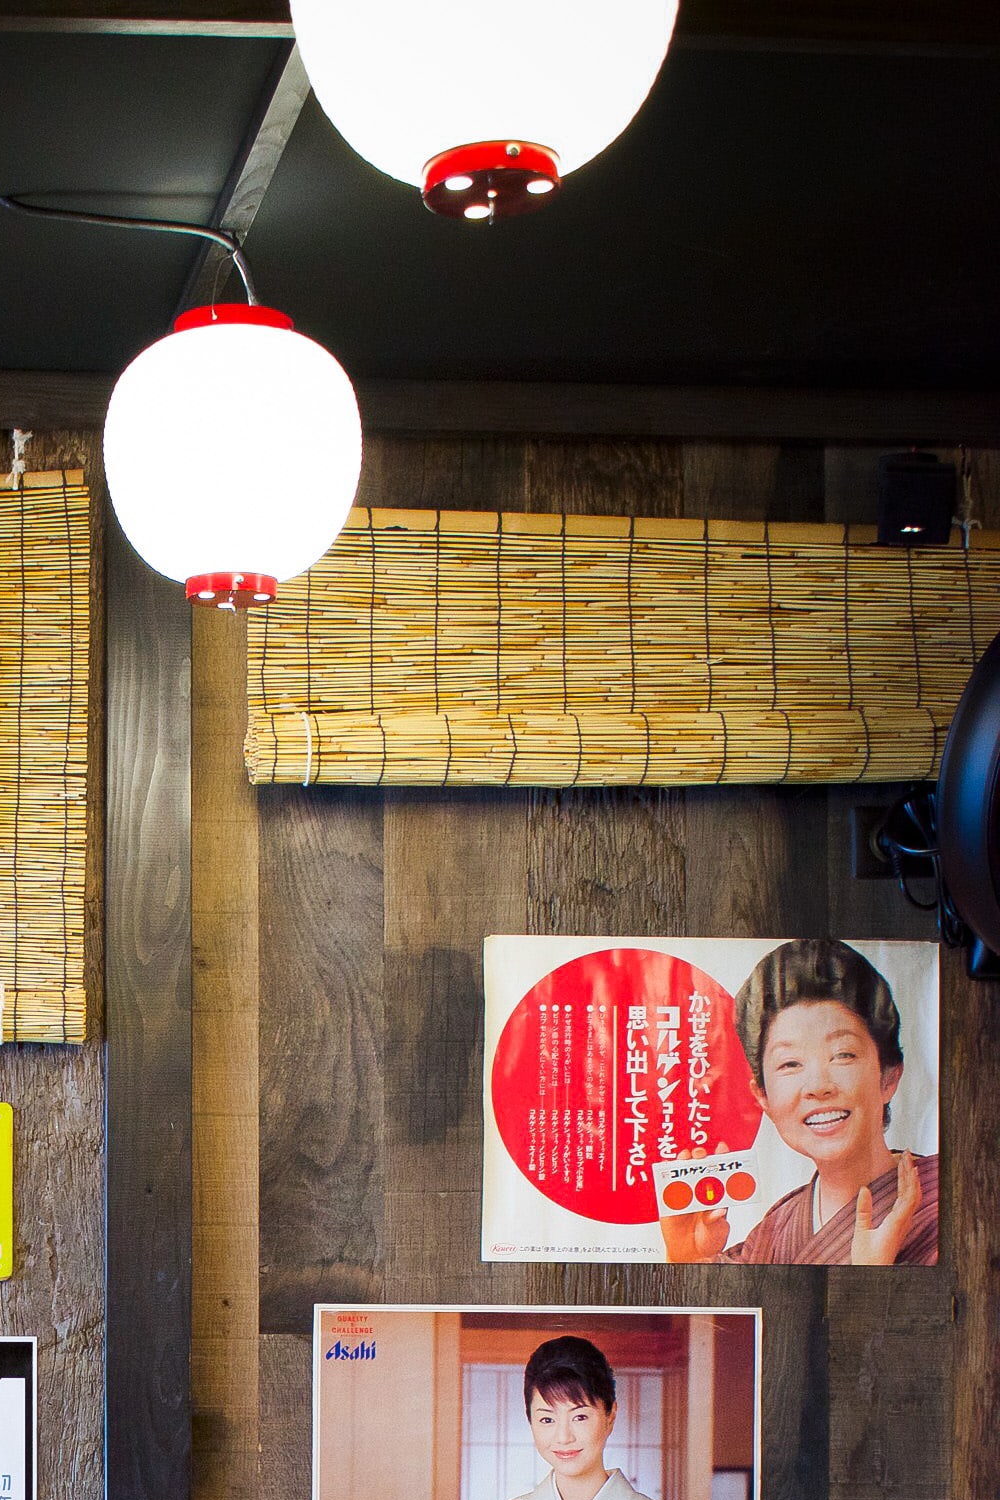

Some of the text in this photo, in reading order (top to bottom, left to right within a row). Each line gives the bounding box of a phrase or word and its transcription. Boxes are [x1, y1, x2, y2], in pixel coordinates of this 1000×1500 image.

[624, 1006, 649, 1186] 思い出して下さい
[656, 1006, 683, 1159] コルゲンコーワを
[687, 991, 711, 1145] かぜをひいたら
[325, 1340, 376, 1361] Asahi
